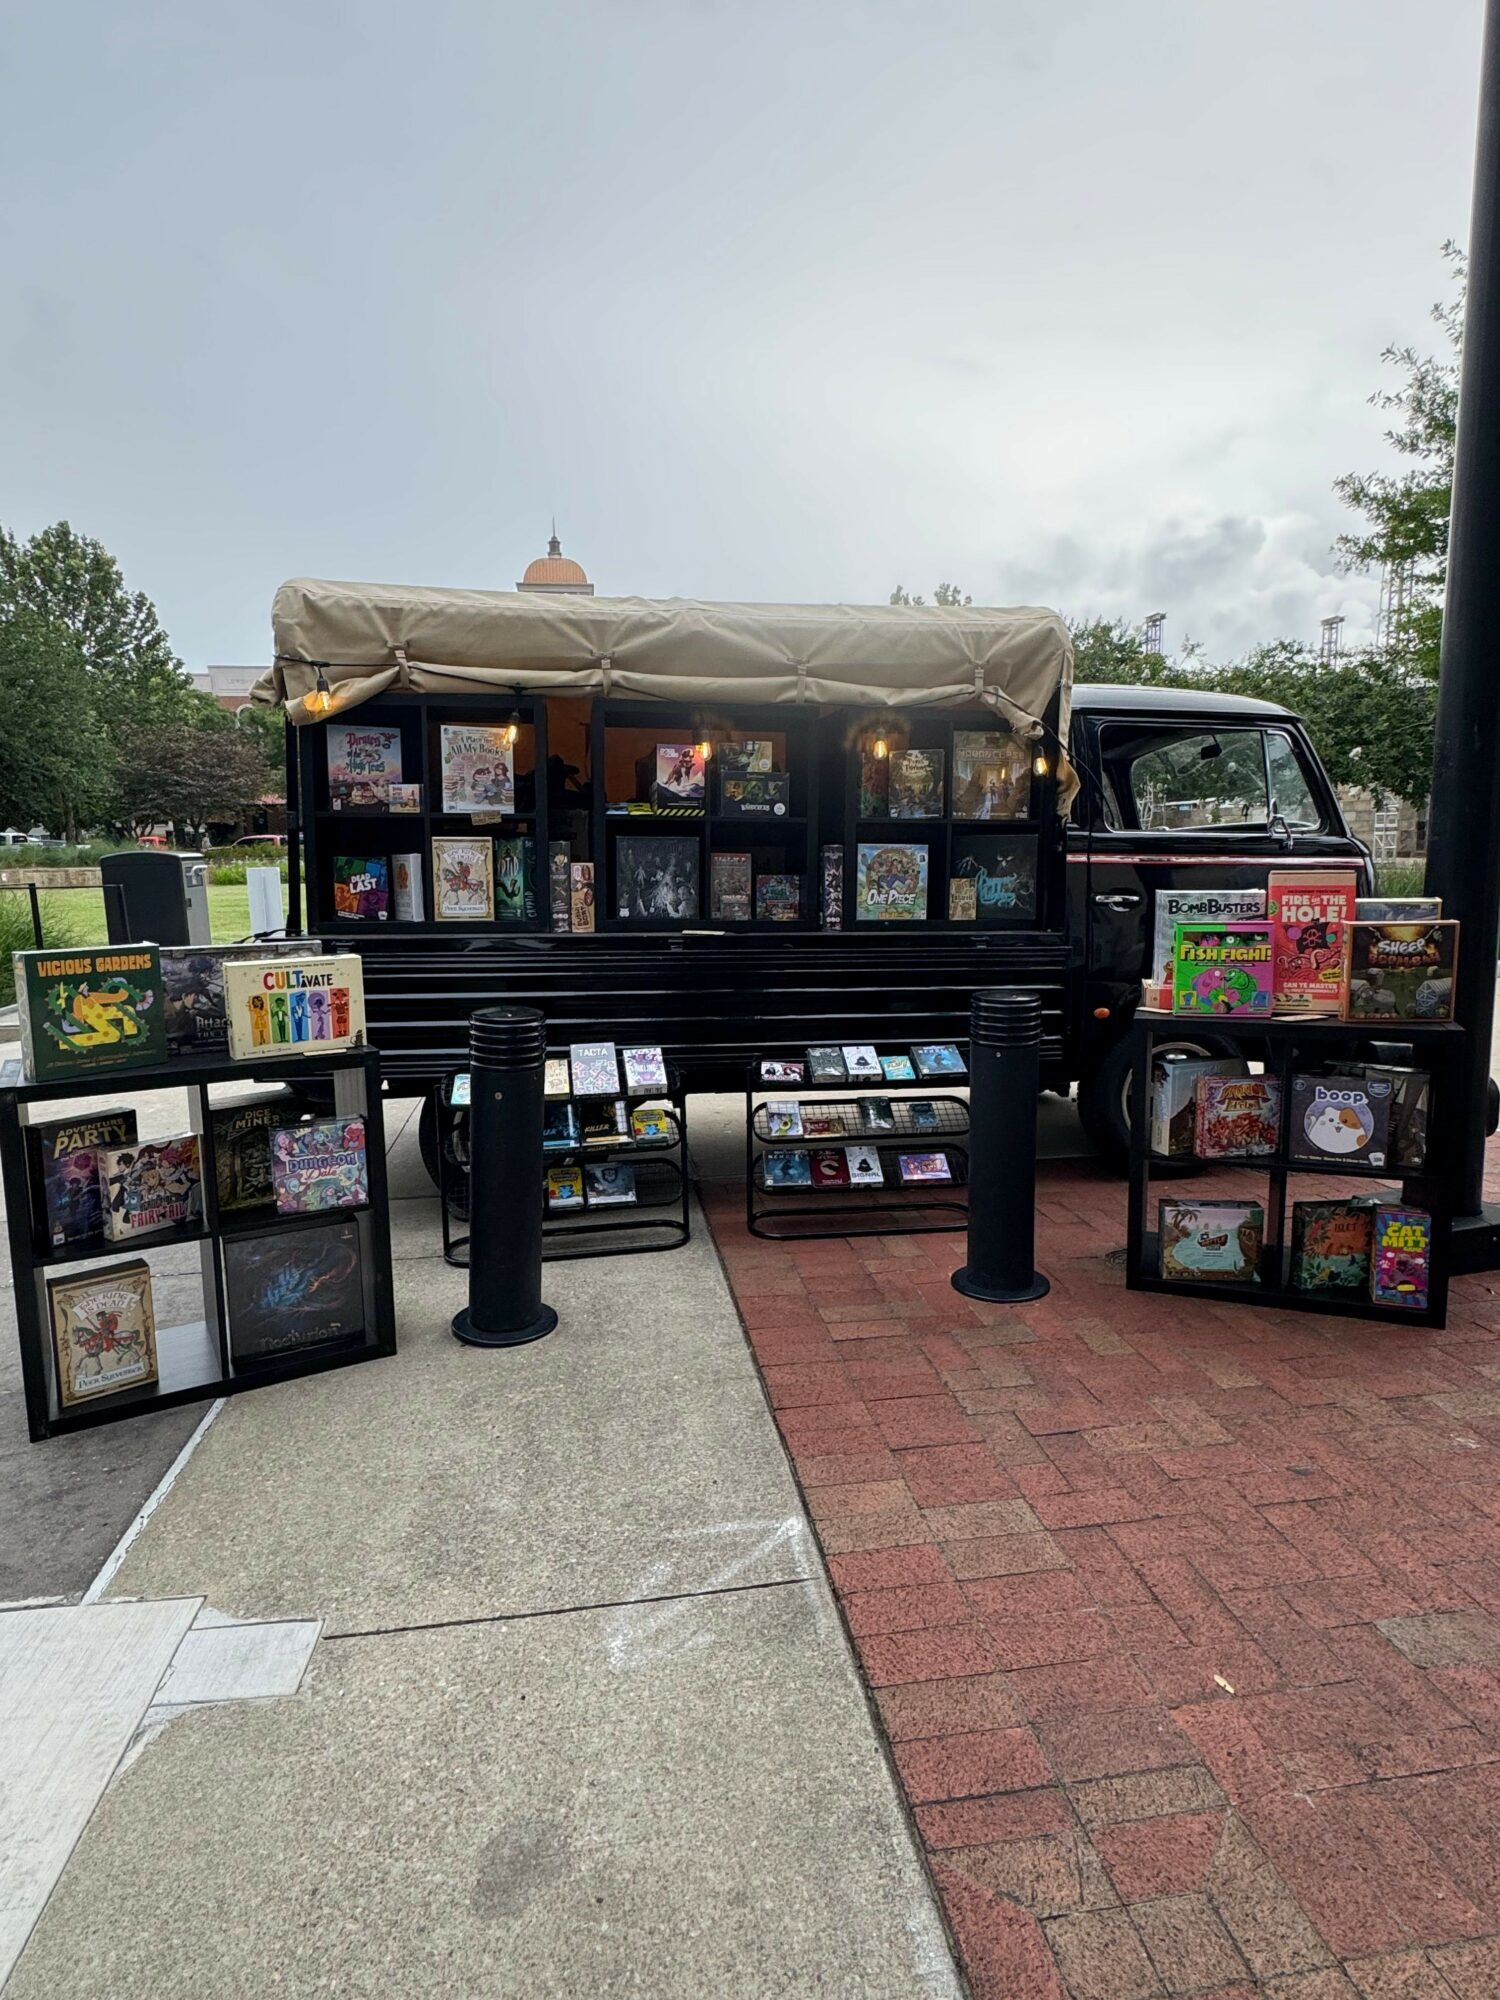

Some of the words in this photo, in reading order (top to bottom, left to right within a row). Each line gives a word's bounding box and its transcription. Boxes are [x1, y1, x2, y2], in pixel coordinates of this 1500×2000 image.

[451, 744, 462, 755] All
[463, 743, 478, 753] My
[479, 744, 504, 757] Books
[351, 873, 371, 883] DEAD
[349, 878, 377, 894] LAST
[867, 889, 887, 905] ONE
[887, 889, 916, 905] PIECE
[1282, 895, 1310, 905] FIRE
[1321, 895, 1347, 905] THE
[1282, 905, 1347, 923] HOLE!
[1180, 944, 1218, 962] FISH
[1221, 944, 1272, 962] FIGHT!
[1378, 938, 1426, 953] SHEEP
[37, 958, 93, 977] VICIOUS
[95, 954, 152, 972] GARDENS
[578, 1048, 608, 1057] TACTA
[244, 1108, 272, 1119] DICE
[58, 1118, 124, 1138] ADVENTURE
[235, 1114, 281, 1129] MINER
[53, 1125, 128, 1159] PARTY
[130, 1207, 162, 1229] FAIRY
[1387, 1226, 1425, 1237] CAT
[1382, 1236, 1428, 1248] MITT
